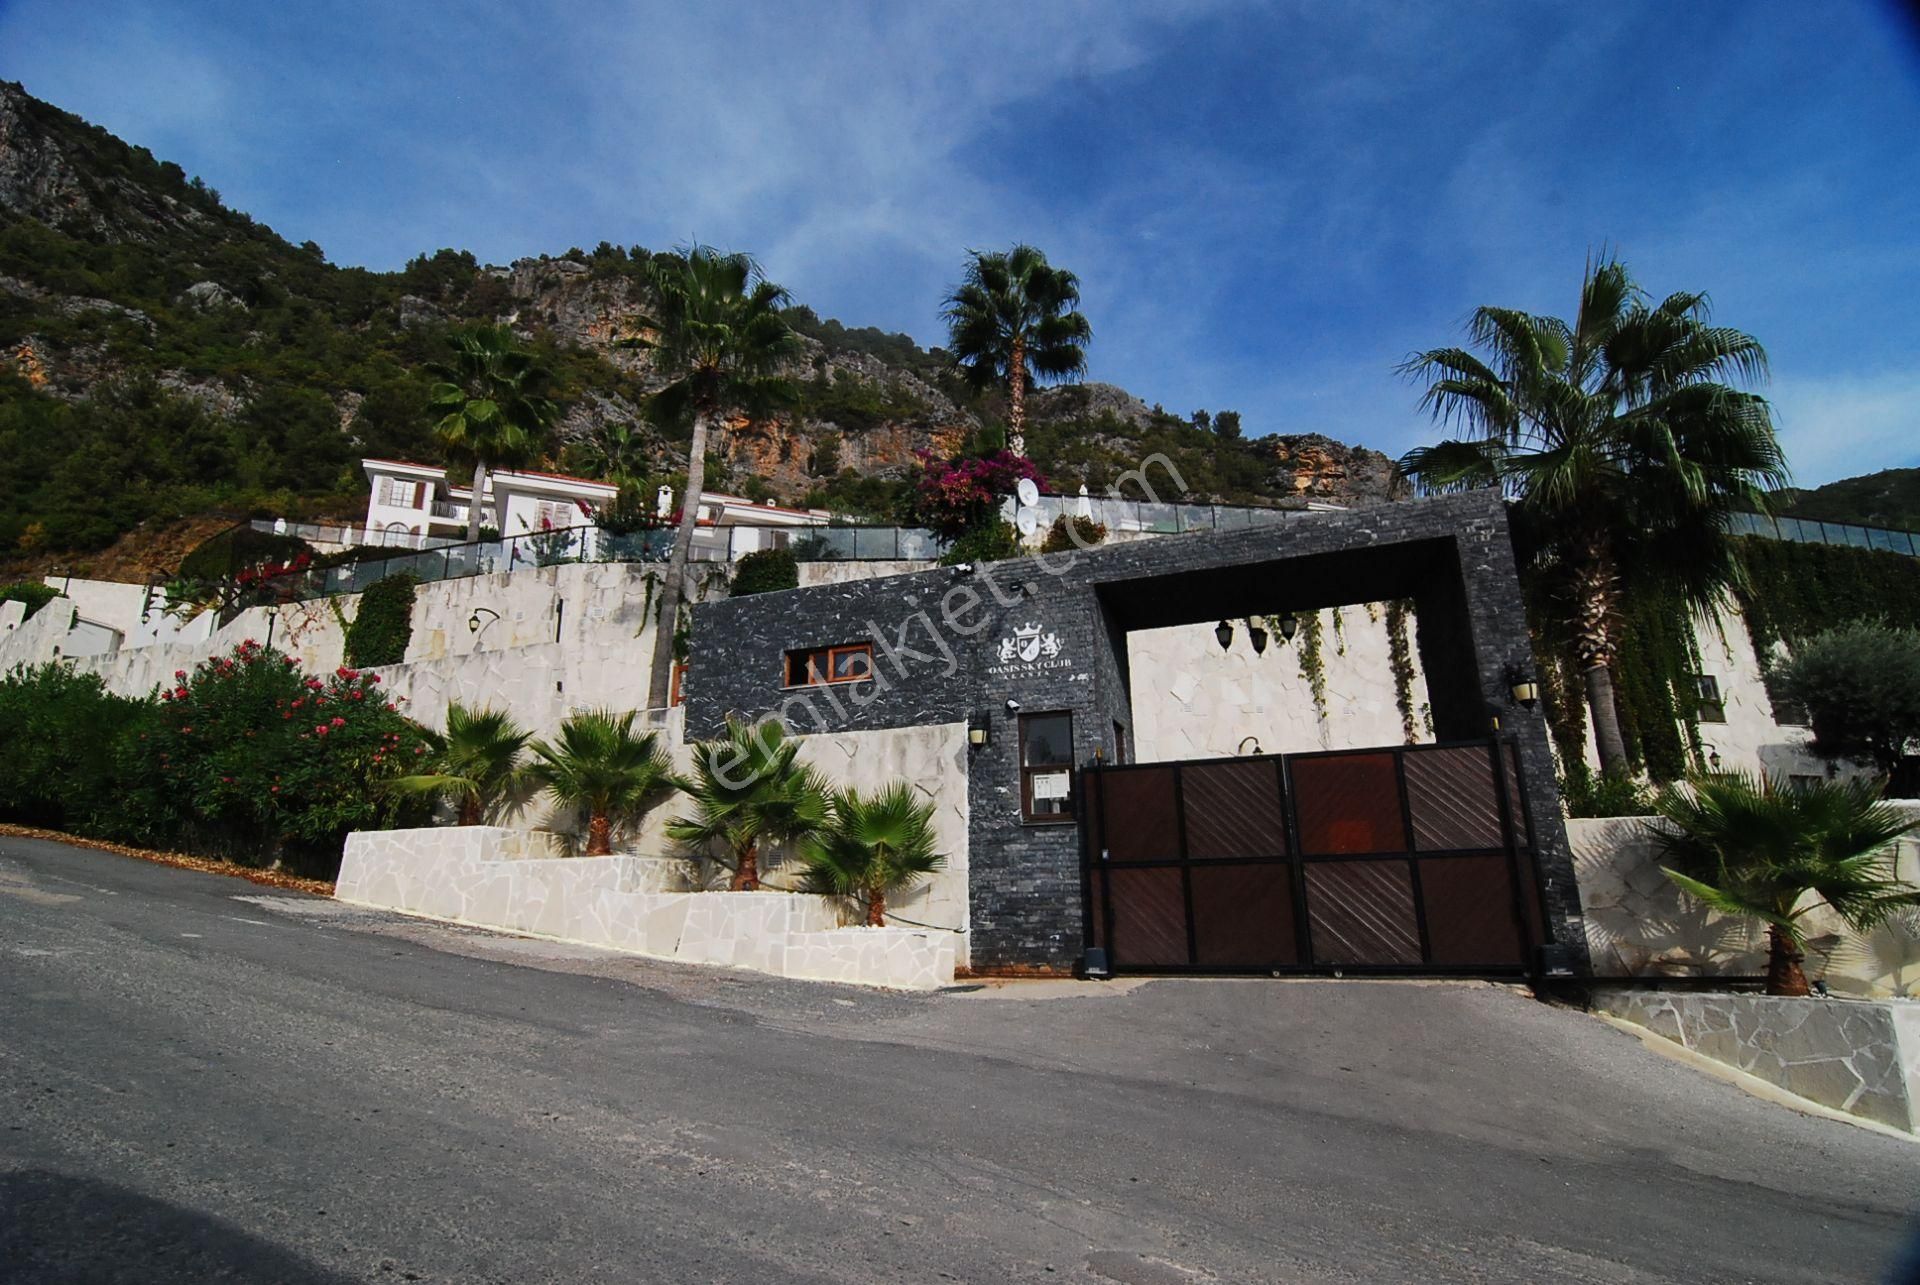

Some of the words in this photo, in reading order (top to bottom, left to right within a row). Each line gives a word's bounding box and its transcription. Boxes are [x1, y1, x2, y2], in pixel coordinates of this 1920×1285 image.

[988, 664, 1021, 674] OASIS
[1021, 662, 1042, 671] SKY
[1043, 659, 1072, 669] CLUB
